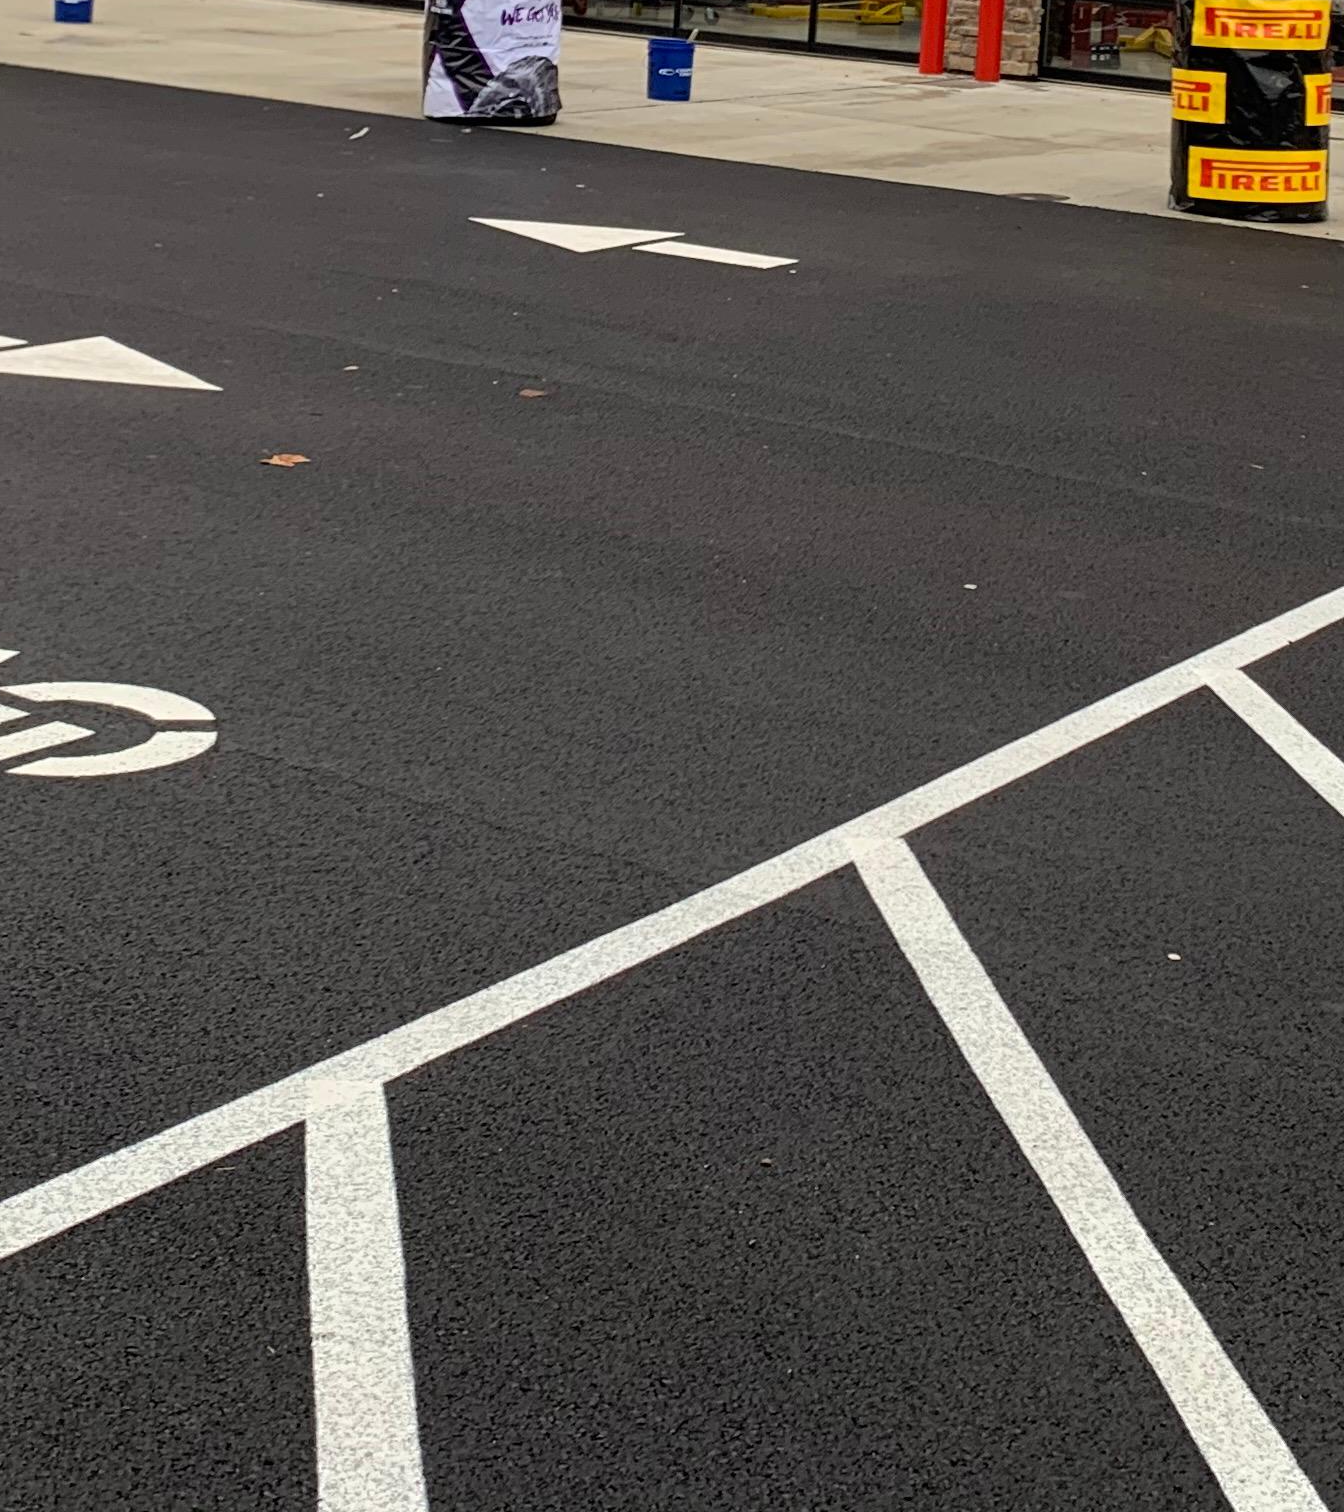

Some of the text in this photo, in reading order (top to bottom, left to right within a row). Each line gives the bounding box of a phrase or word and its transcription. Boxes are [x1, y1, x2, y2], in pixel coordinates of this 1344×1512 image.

[501, 4, 524, 26] WE
[1206, 7, 1323, 39] PIRELLI
[1201, 158, 1320, 193] PIRELLI
